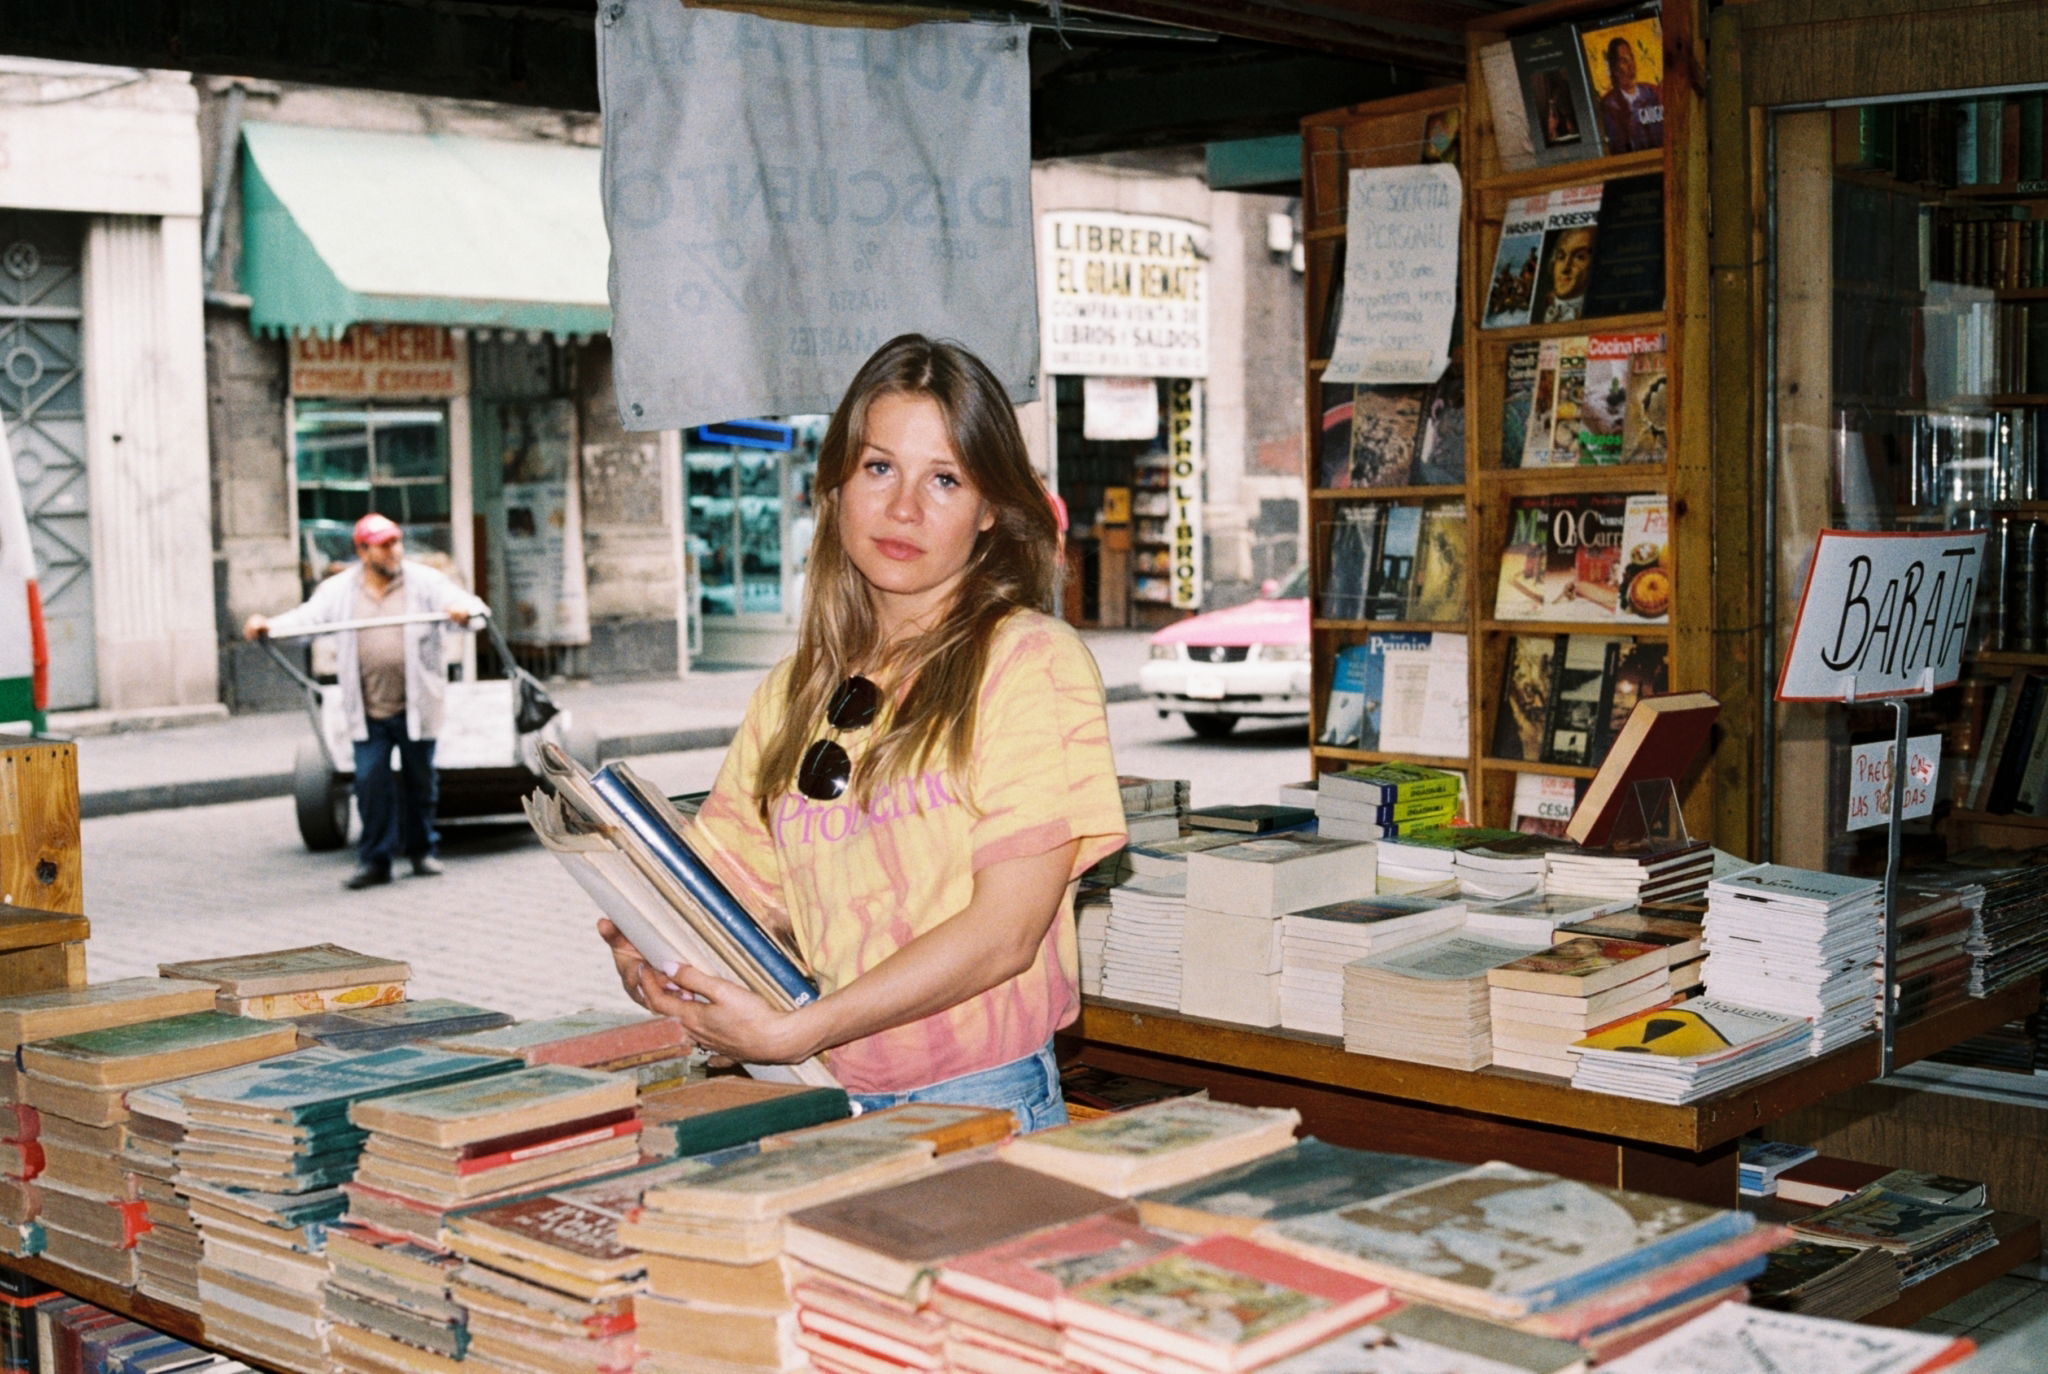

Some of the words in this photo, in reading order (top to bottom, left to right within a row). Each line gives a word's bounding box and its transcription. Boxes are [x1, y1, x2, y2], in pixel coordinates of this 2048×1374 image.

[1055, 222, 1203, 258] LIBRERIA
[1057, 257, 1078, 294] EL
[1086, 260, 1131, 297] GRAN
[1053, 323, 1116, 345] LIBROS
[1133, 326, 1200, 349] SALDOS
[1588, 339, 1632, 355] Cocina
[1175, 485, 1195, 600] LIBROS
[1820, 547, 1976, 680] BARATA
[1851, 796, 1869, 817] LAS
